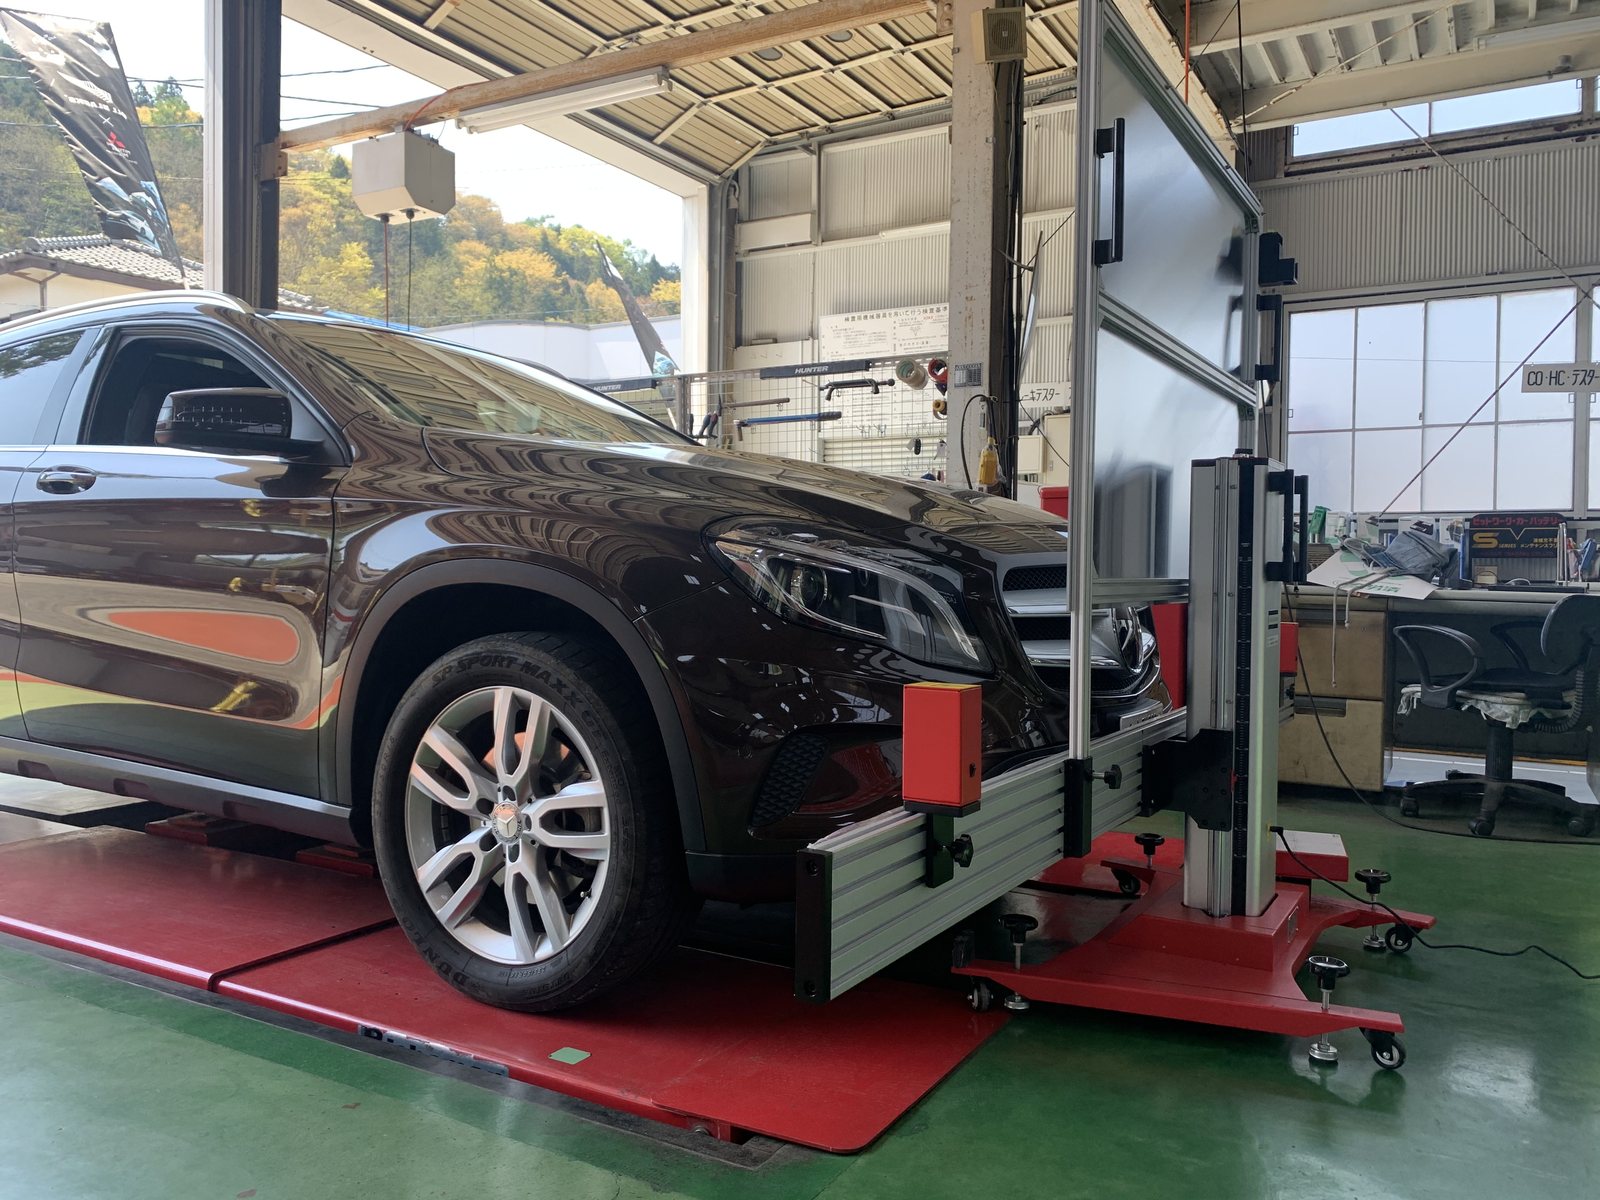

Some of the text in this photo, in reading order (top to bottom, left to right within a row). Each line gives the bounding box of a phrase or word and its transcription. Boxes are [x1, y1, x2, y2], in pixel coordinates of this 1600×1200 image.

[794, 365, 829, 375] HUNTER
[1020, 388, 1061, 402] ーキテスター
[431, 666, 453, 688] SP
[456, 654, 519, 674] SPORT
[520, 660, 582, 709] MAXX
[400, 915, 470, 986] DUNLO
